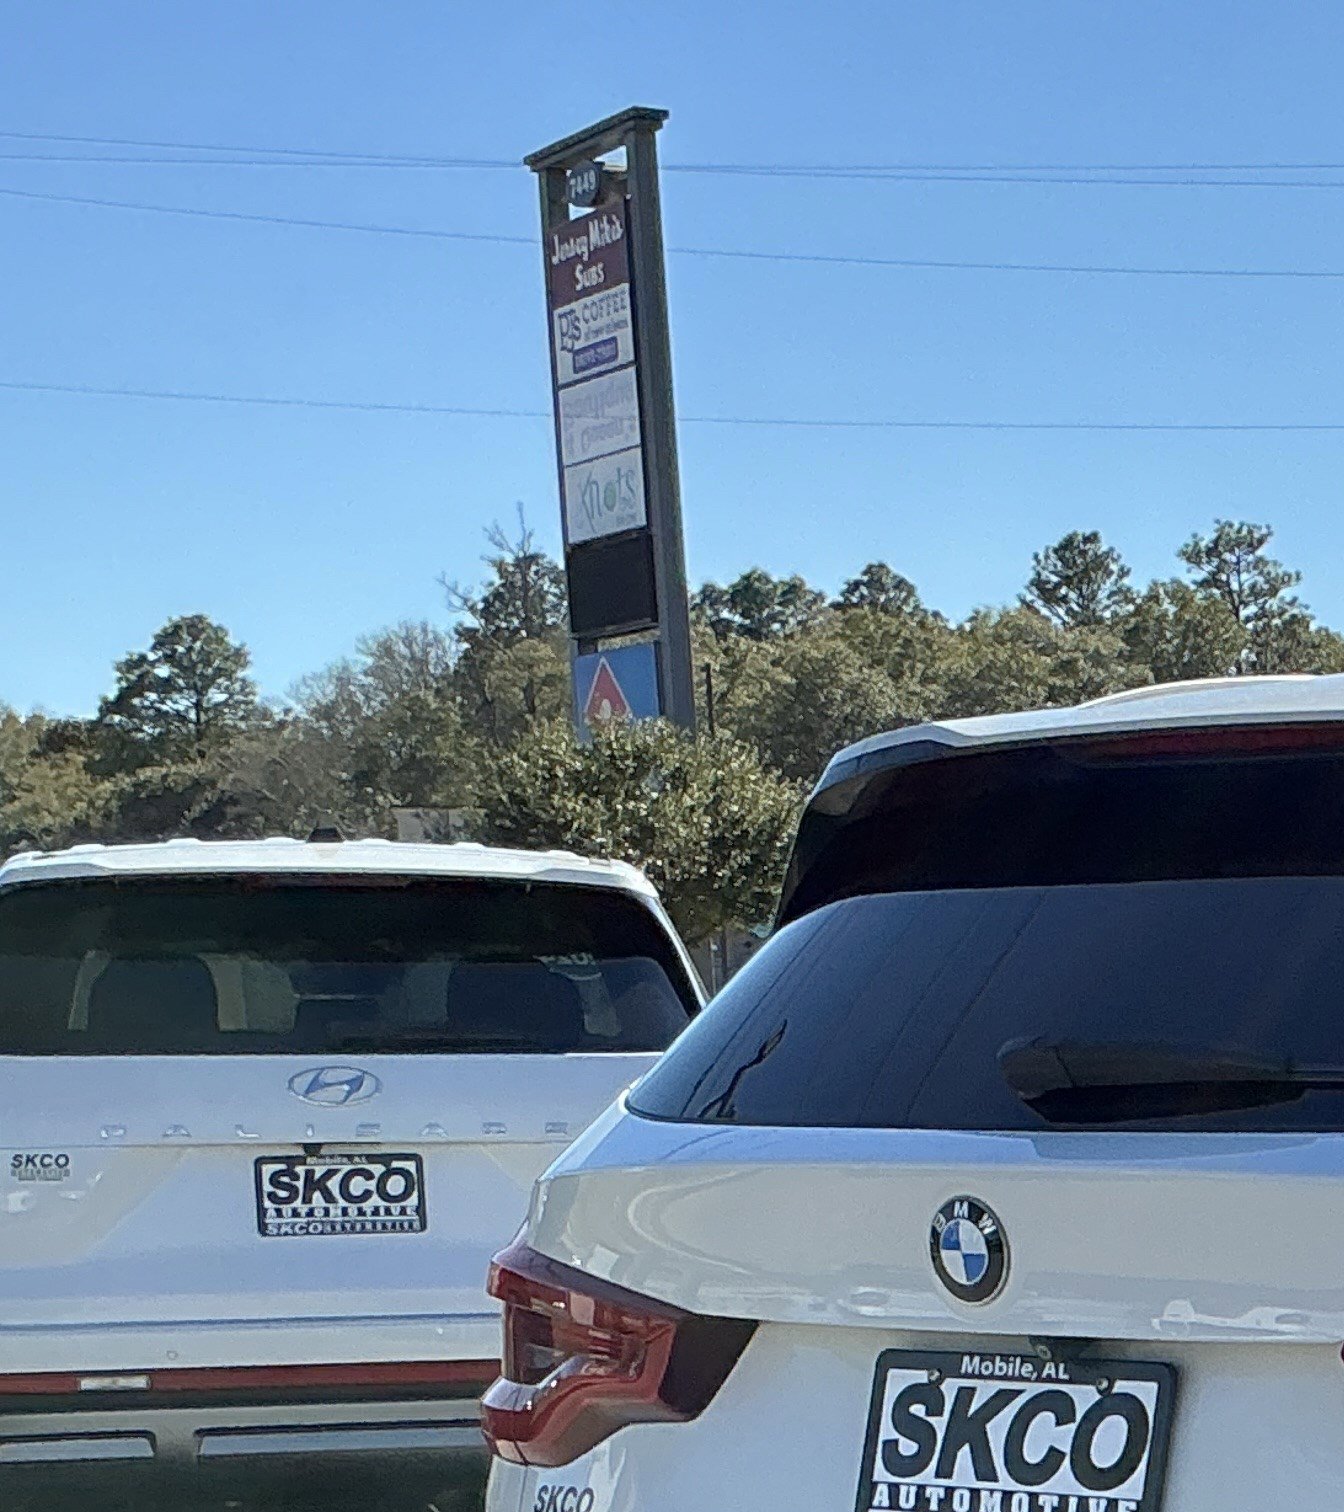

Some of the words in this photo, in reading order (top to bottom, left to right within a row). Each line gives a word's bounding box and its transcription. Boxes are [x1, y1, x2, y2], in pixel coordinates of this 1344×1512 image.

[11, 1153, 70, 1169] SKCO
[266, 1166, 416, 1206] SKCO
[265, 1205, 418, 1219] AUTOMOTIVE
[933, 1201, 997, 1235] BMW
[266, 1222, 323, 1235] SKCO
[960, 1355, 1038, 1379] Mobile,
[1041, 1360, 1070, 1381] AL
[881, 1382, 1150, 1492] SKCO
